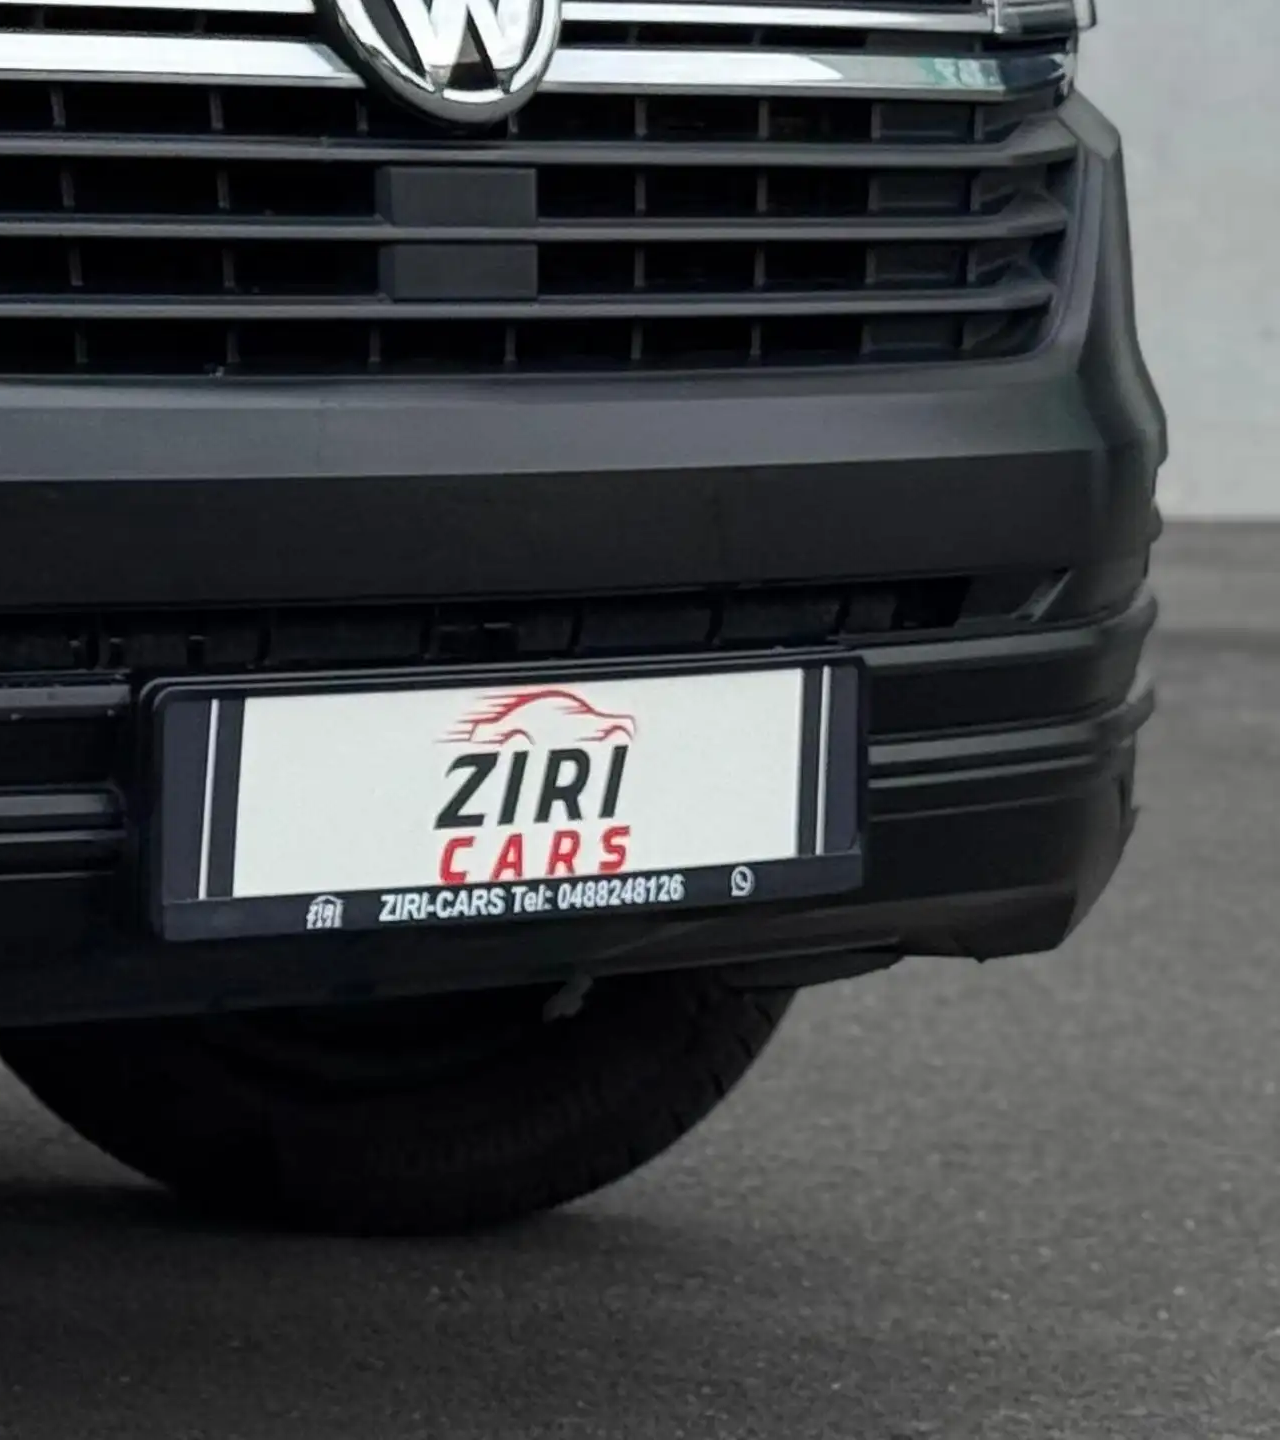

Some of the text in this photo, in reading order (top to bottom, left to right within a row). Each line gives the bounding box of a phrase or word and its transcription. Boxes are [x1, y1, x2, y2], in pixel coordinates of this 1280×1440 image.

[434, 745, 629, 829] ZIRI
[440, 824, 631, 885] CARS
[379, 874, 685, 922] ZIRI-CARS Tel: 0488248126
